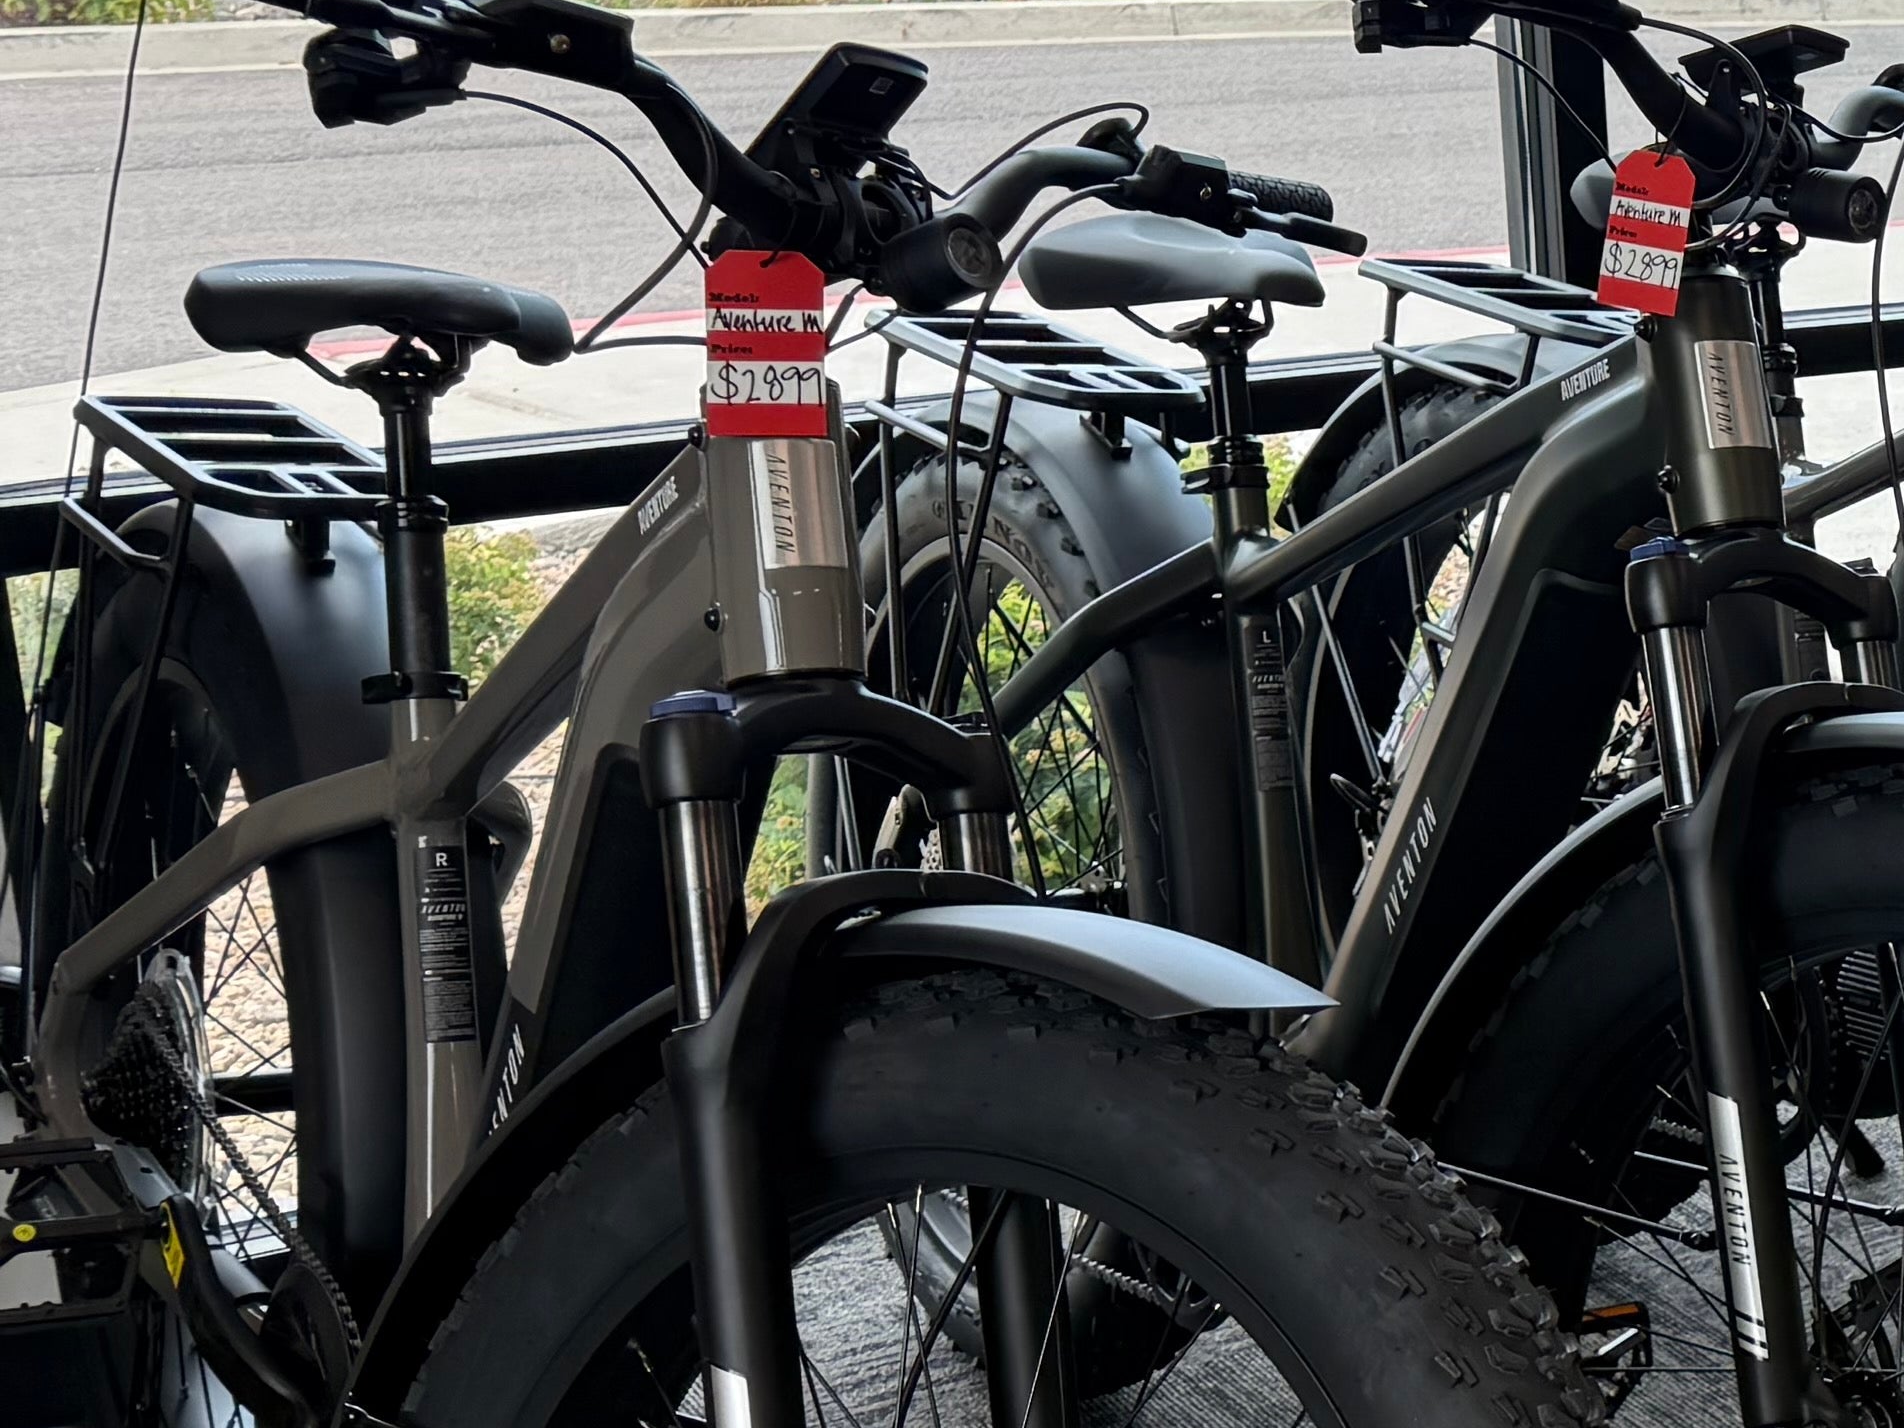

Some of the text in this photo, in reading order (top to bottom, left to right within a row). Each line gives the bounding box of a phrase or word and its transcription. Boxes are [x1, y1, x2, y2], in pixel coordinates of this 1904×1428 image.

[1603, 244, 1680, 290] $2899
[711, 360, 823, 406] $2899
[1560, 358, 1611, 402] AVENTURE
[1708, 352, 1736, 436] AVENTON
[637, 476, 679, 536] AVENTURE
[766, 453, 796, 554] AVENTON
[435, 852, 448, 867] R
[1383, 795, 1437, 936] AVENTON
[1717, 1151, 1752, 1268] AVENTON
